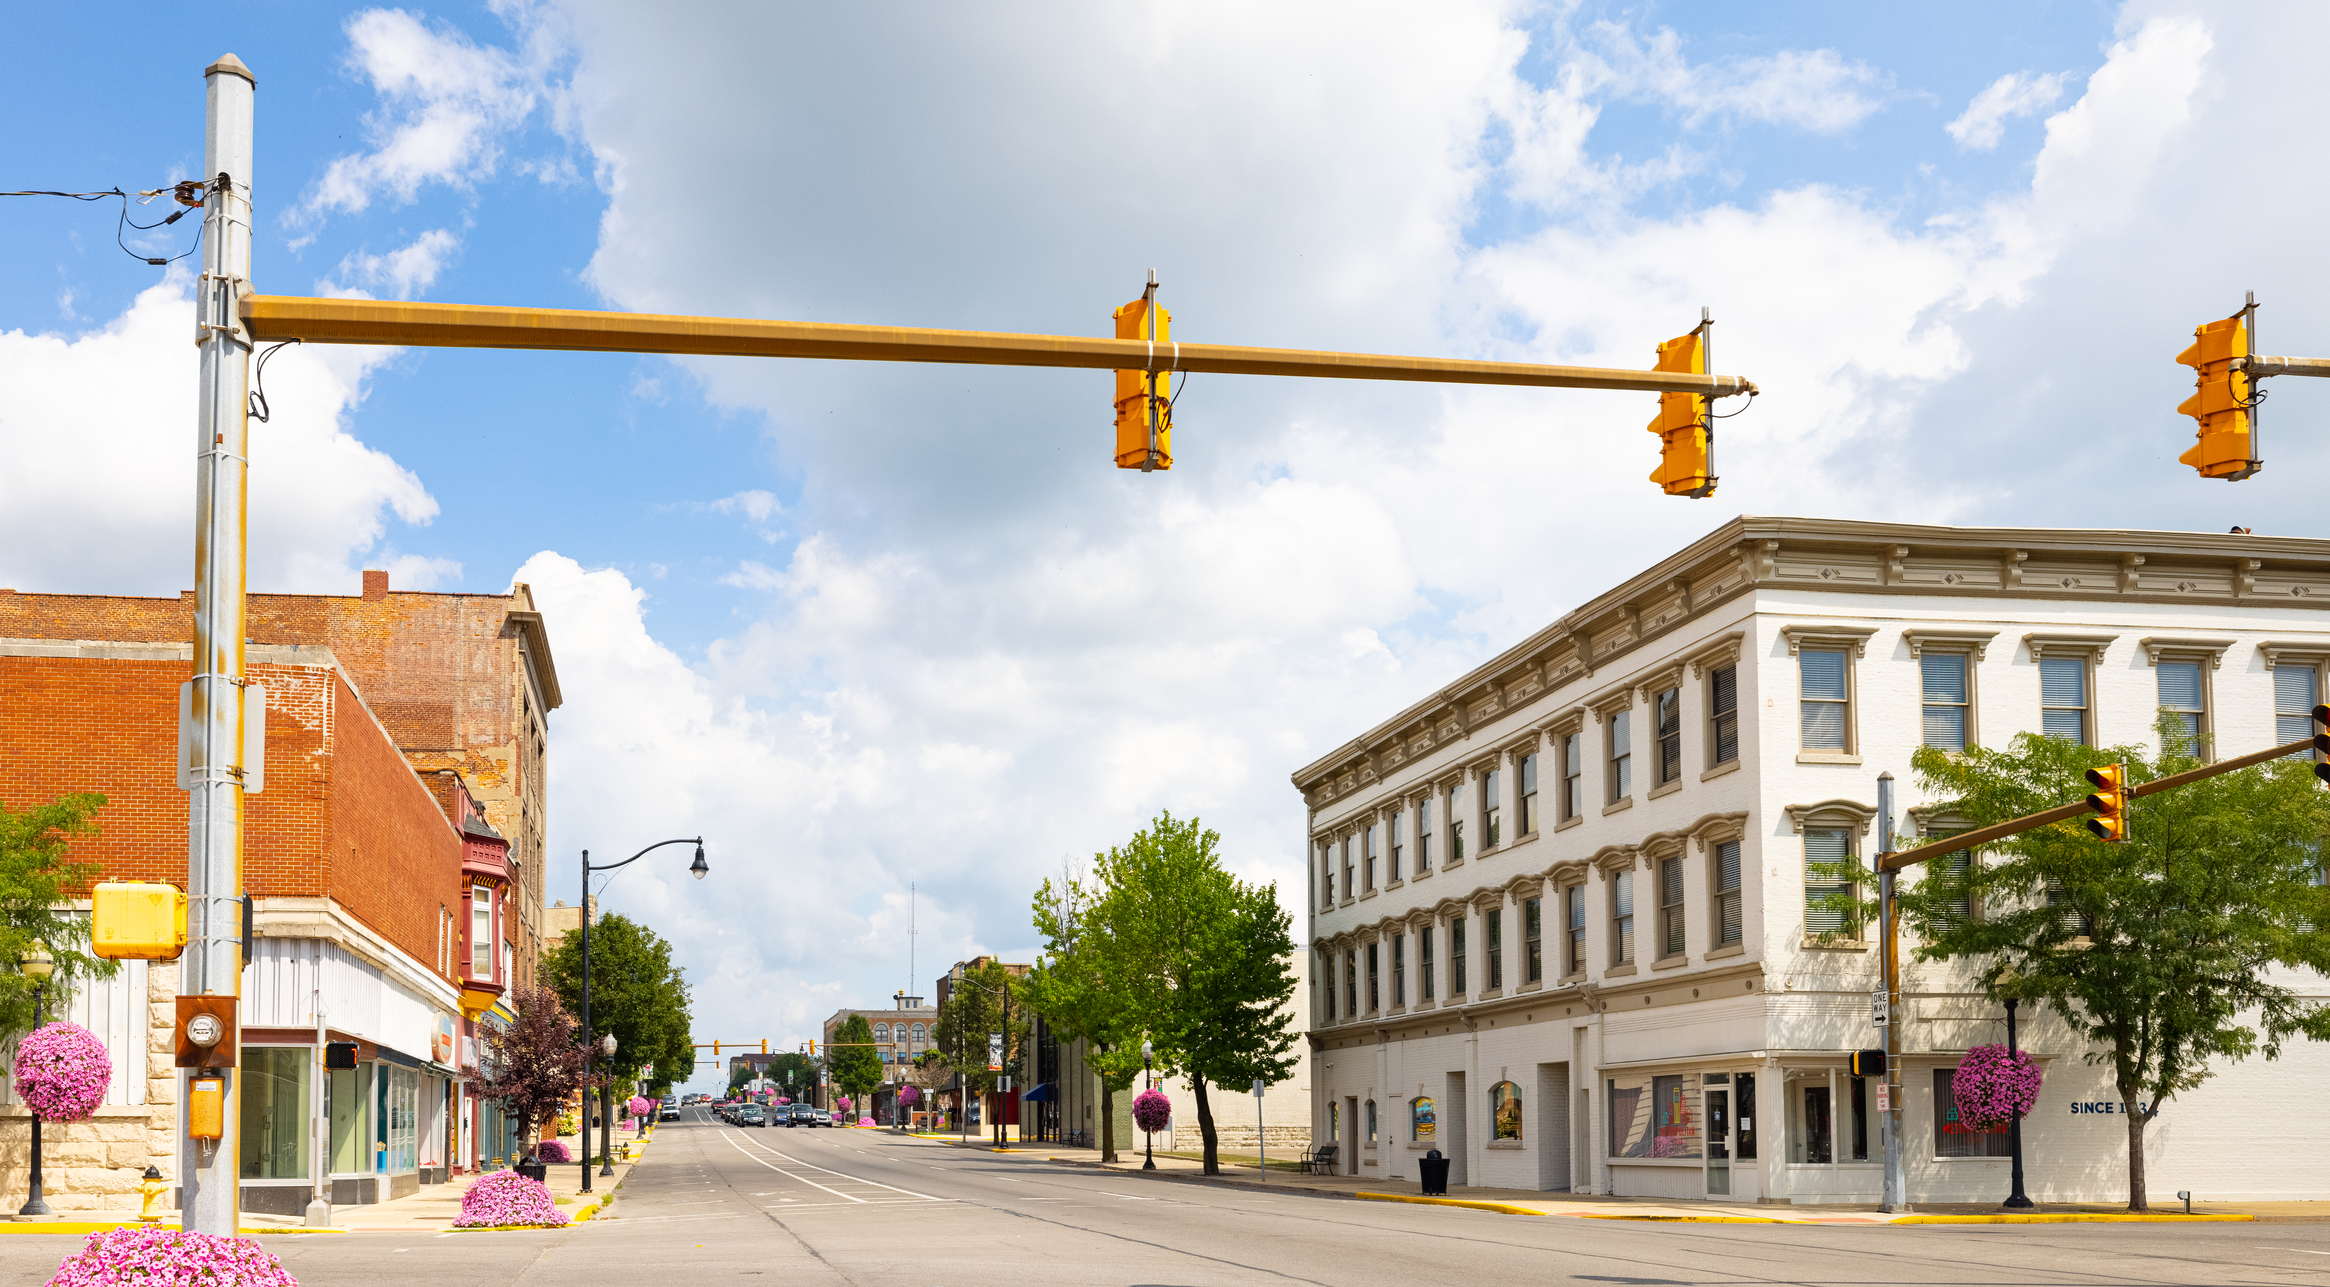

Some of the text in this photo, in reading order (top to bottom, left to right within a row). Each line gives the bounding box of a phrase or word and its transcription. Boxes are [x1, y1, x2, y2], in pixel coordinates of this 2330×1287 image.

[1874, 993, 1886, 1002] ONE
[1874, 1003, 1887, 1012] WAY
[2071, 1102, 2159, 1117] SINCE 13
